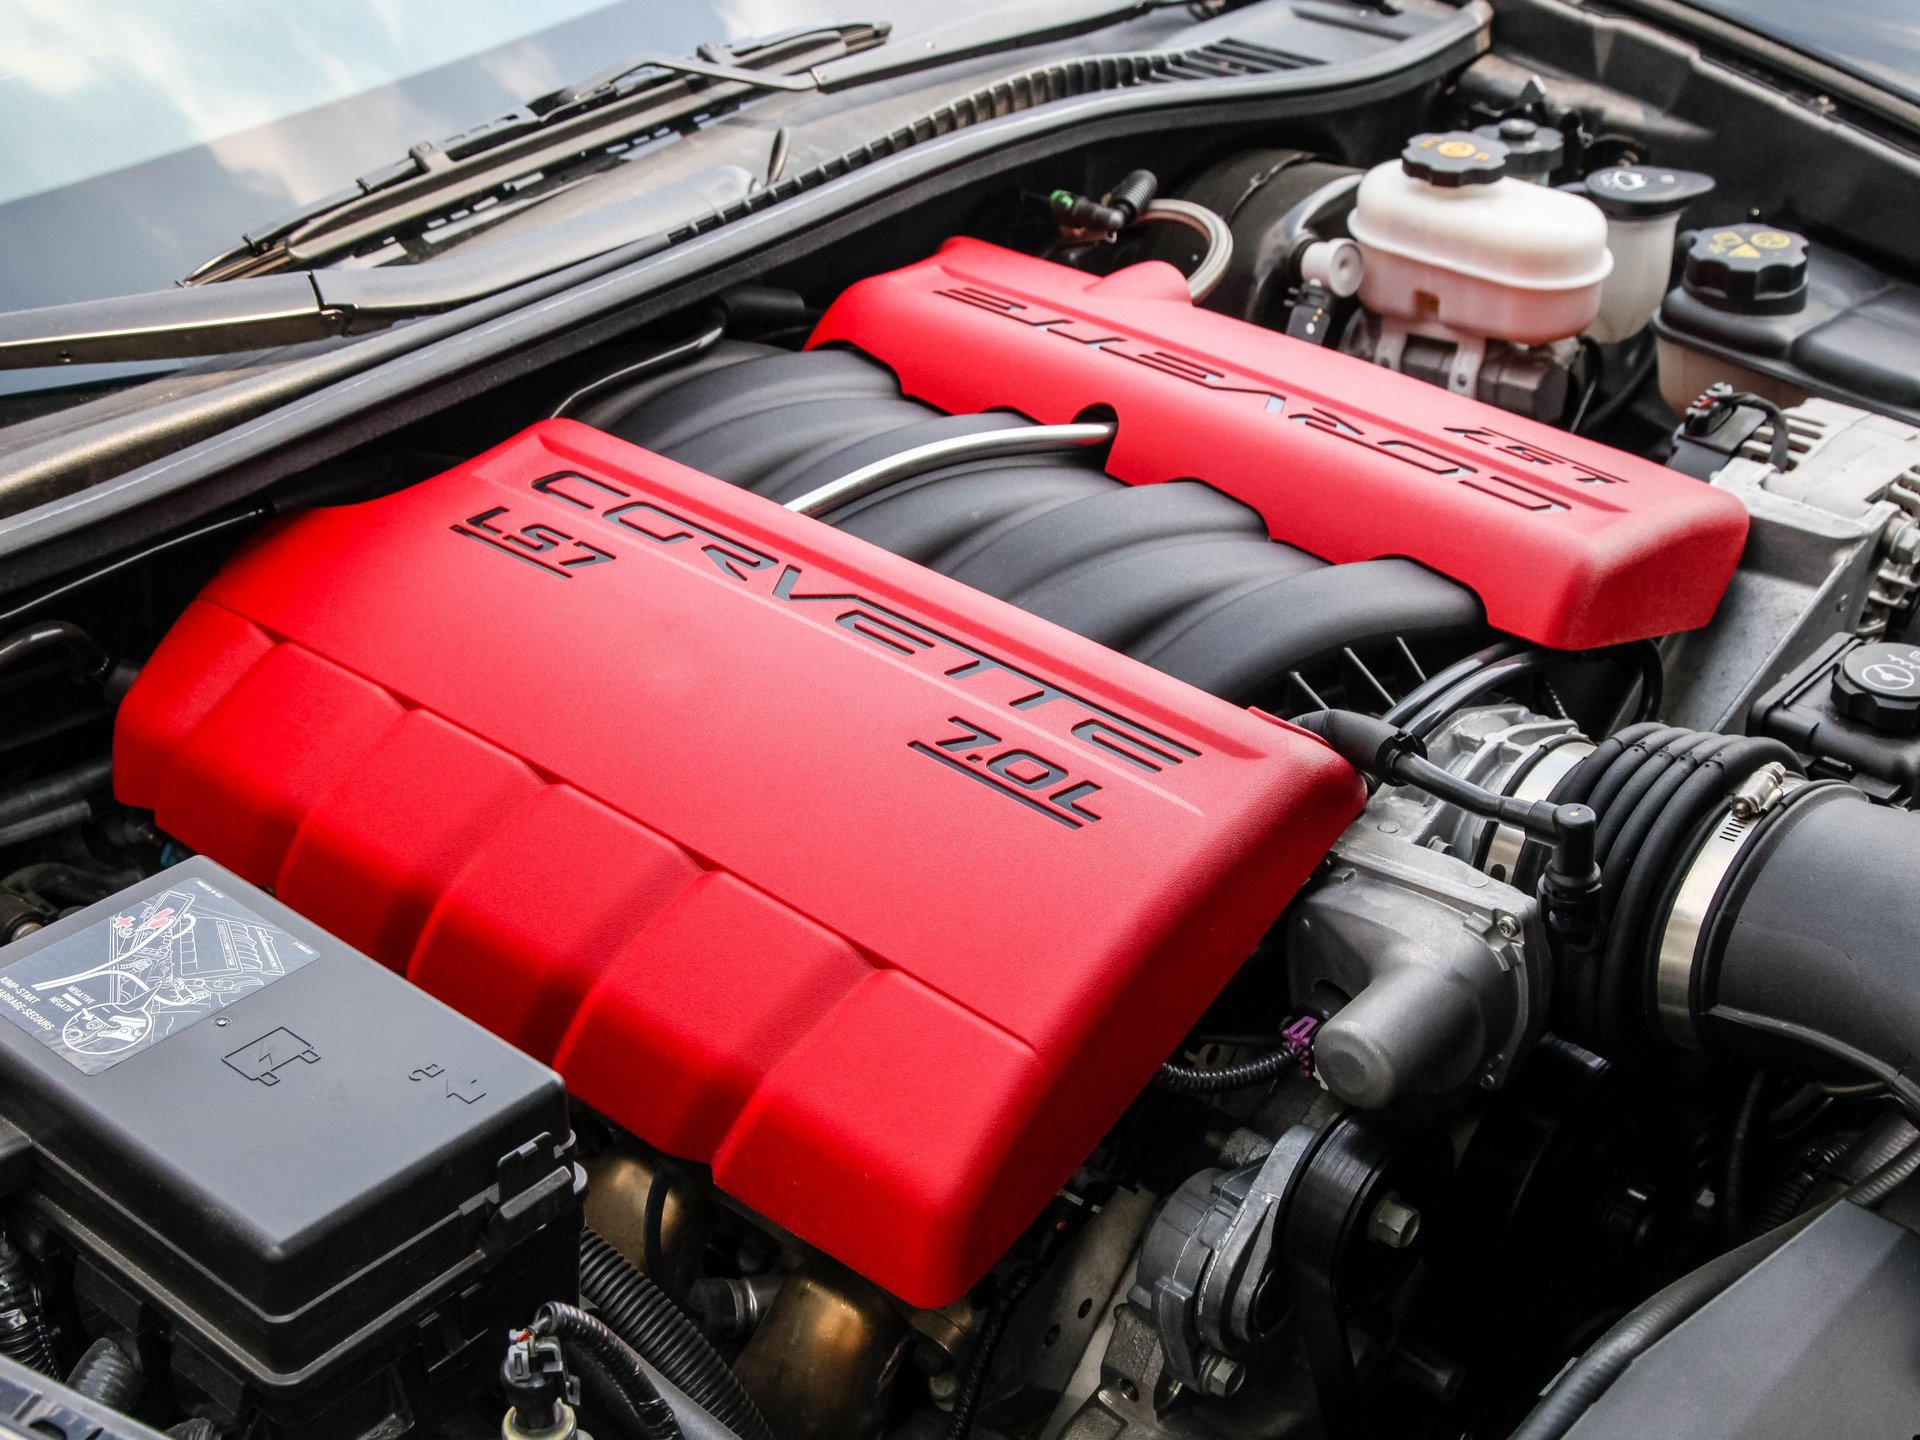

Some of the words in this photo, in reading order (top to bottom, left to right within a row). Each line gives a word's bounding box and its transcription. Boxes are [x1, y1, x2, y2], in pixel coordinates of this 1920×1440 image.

[933, 286, 1574, 515] CORVETTE
[1443, 427, 1617, 485] LS7
[465, 505, 617, 569] LS7
[531, 470, 1202, 774] CORVETTE
[936, 715, 1103, 824] 7.0L
[67, 985, 96, 1005] NEGATIVE
